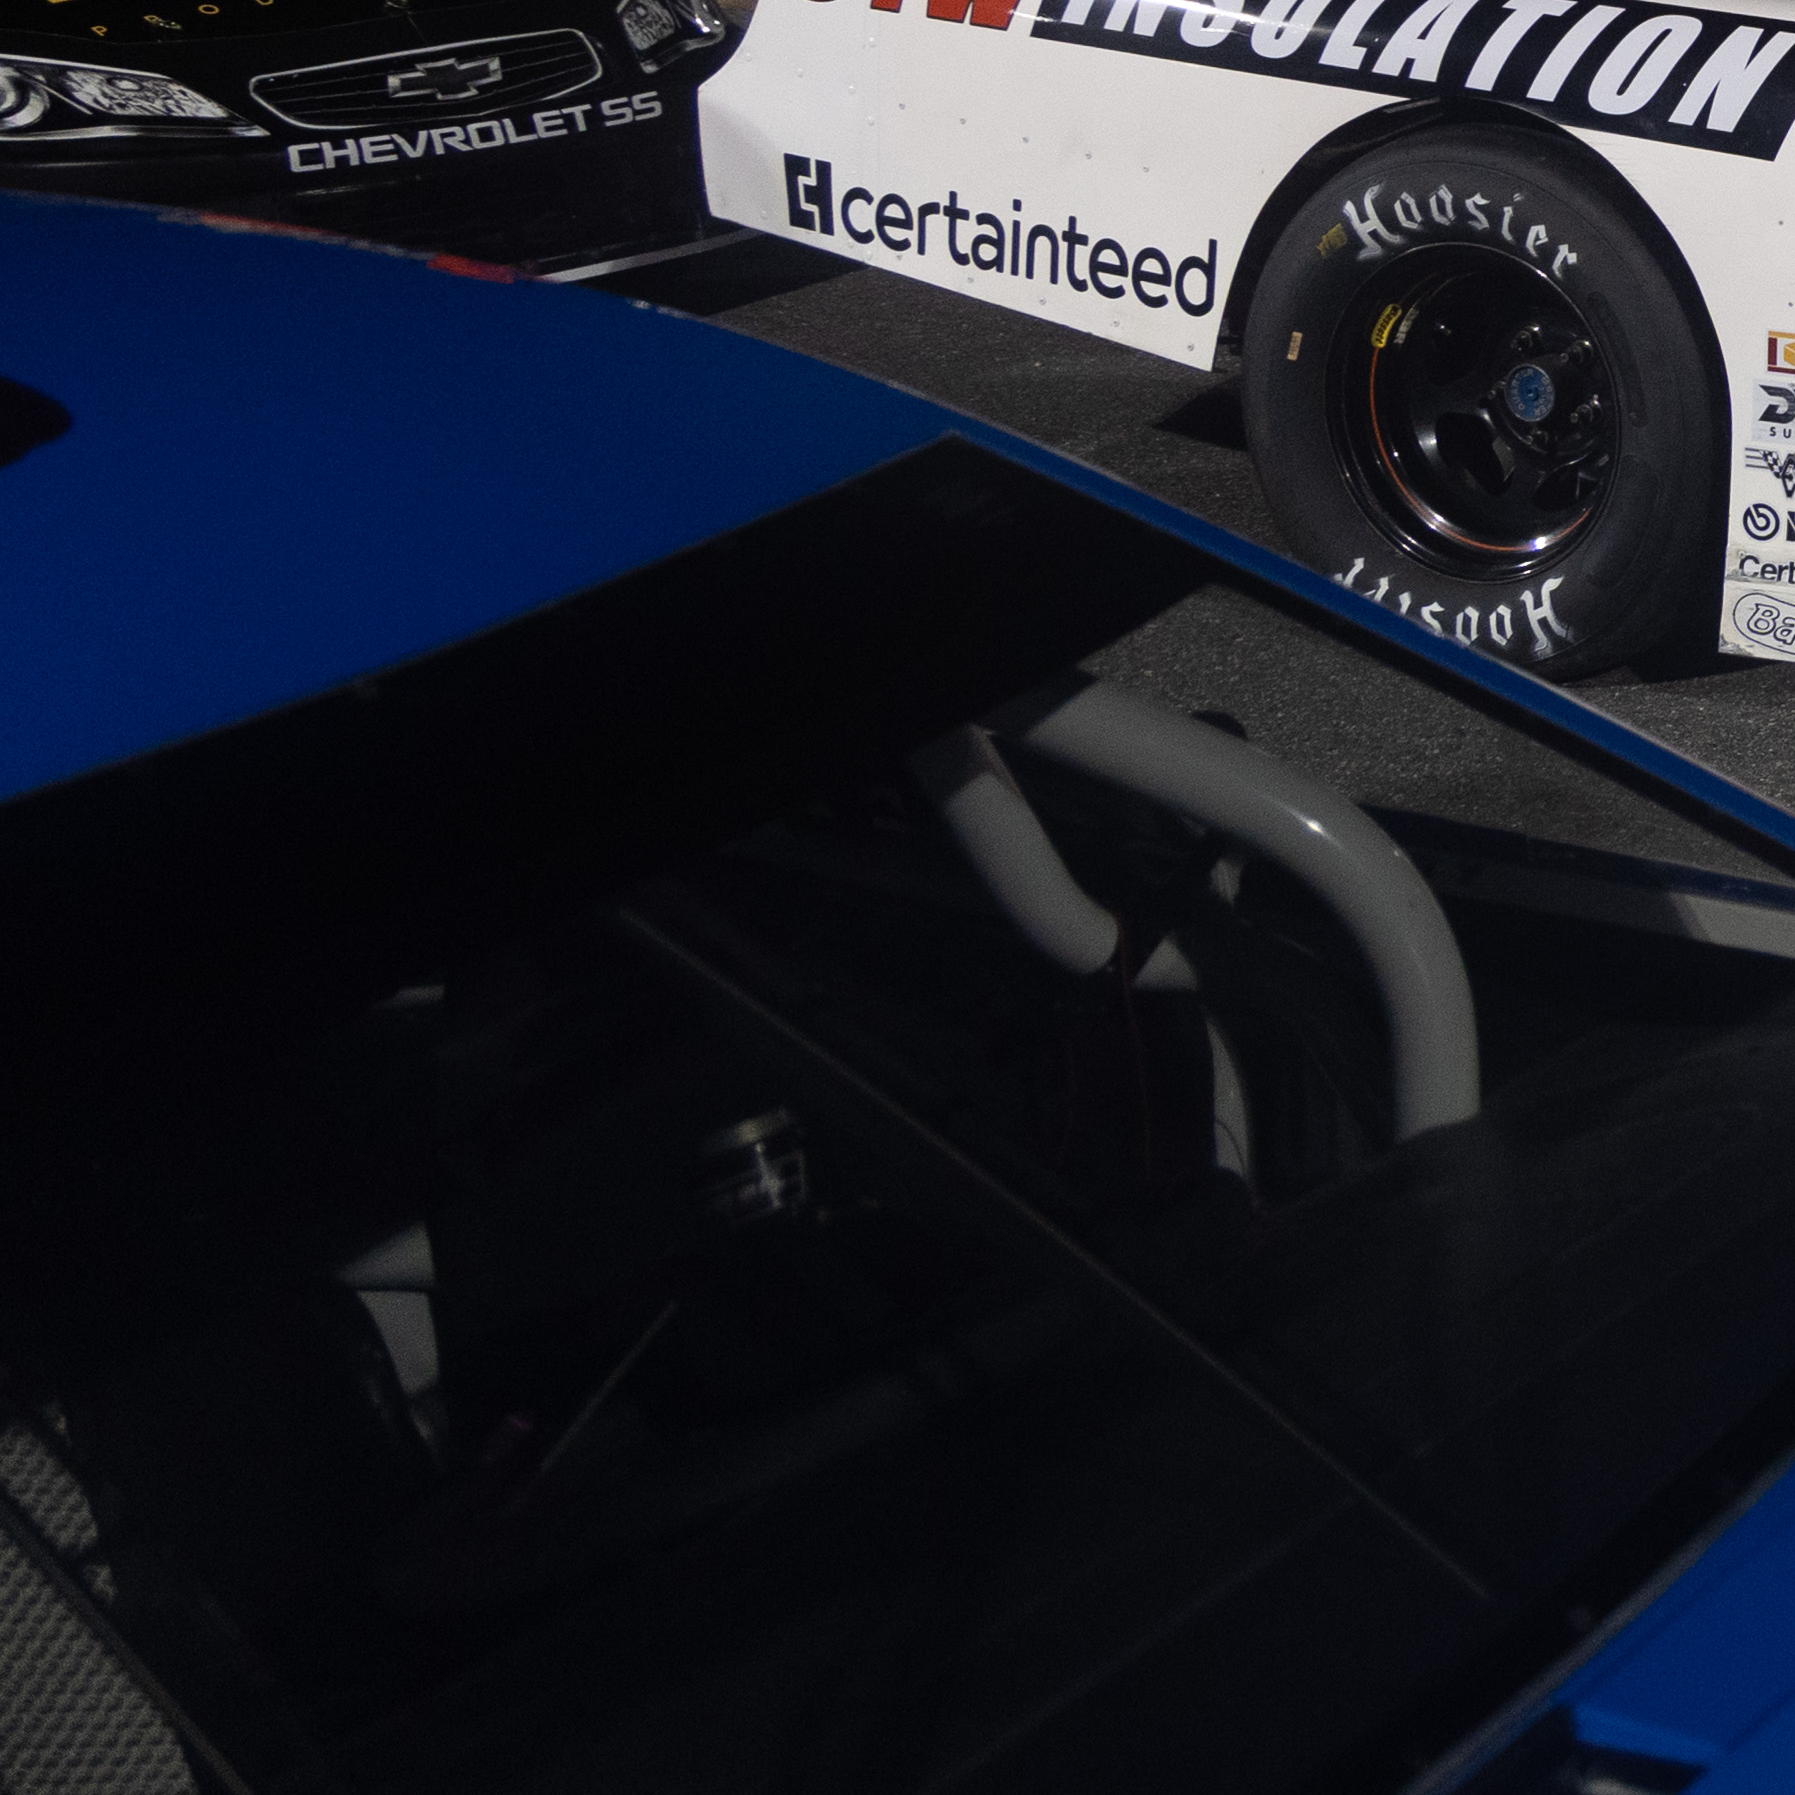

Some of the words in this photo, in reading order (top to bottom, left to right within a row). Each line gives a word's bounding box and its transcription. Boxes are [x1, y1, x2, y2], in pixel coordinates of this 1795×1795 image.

[286, 103, 594, 174] CHEVROLET
[602, 90, 663, 128] SS
[840, 189, 1218, 317] certainteed
[1341, 181, 1580, 278] Hoosier
